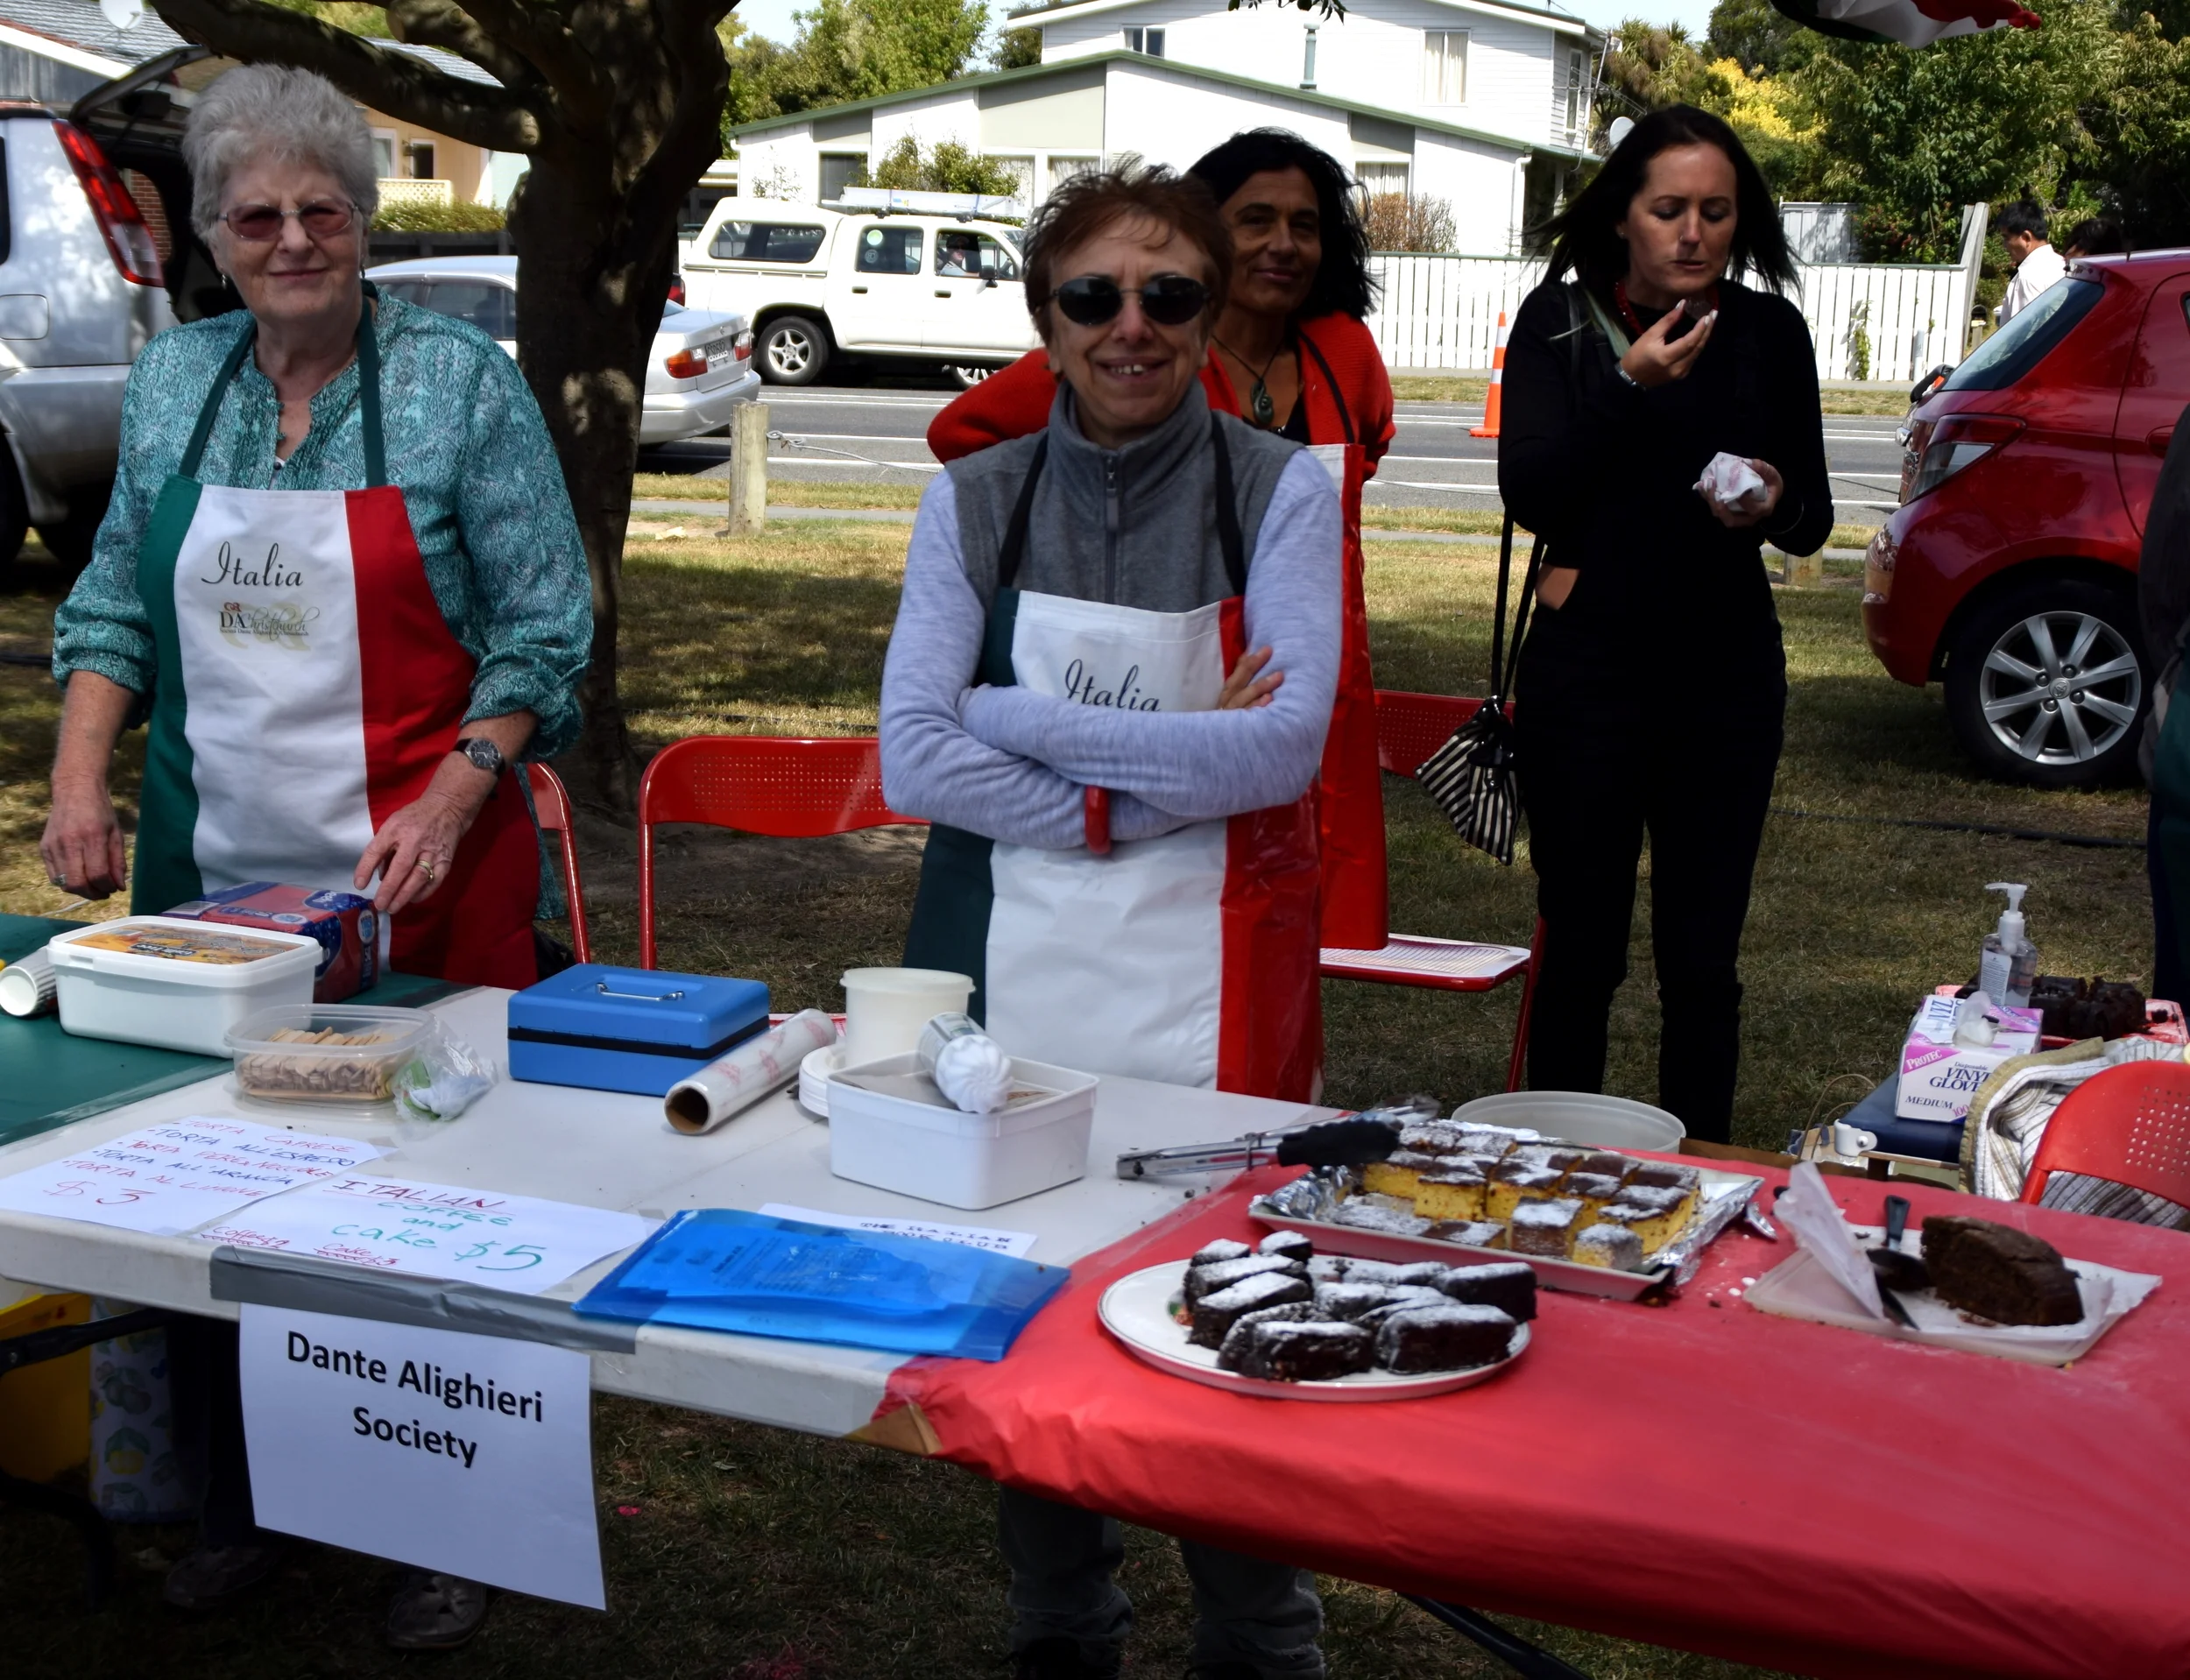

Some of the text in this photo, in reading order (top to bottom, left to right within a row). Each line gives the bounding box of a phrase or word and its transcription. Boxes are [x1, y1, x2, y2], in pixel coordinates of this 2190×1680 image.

[201, 540, 304, 587] Italia
[1064, 659, 1162, 712] Italia
[1906, 1049, 1943, 1069] PROTEC
[1905, 1095, 1953, 1110] MEDIUM
[127, 1139, 181, 1154] TORTA
[154, 1128, 221, 1146] TORTA
[95, 1148, 155, 1164] TORTA
[64, 1160, 137, 1178] TORTA
[332, 1180, 506, 1209] ITALIAN
[401, 1217, 464, 1232] and
[453, 1240, 548, 1271] $5
[286, 1331, 543, 1422] Dante Alighieri
[352, 1406, 477, 1469] Society
